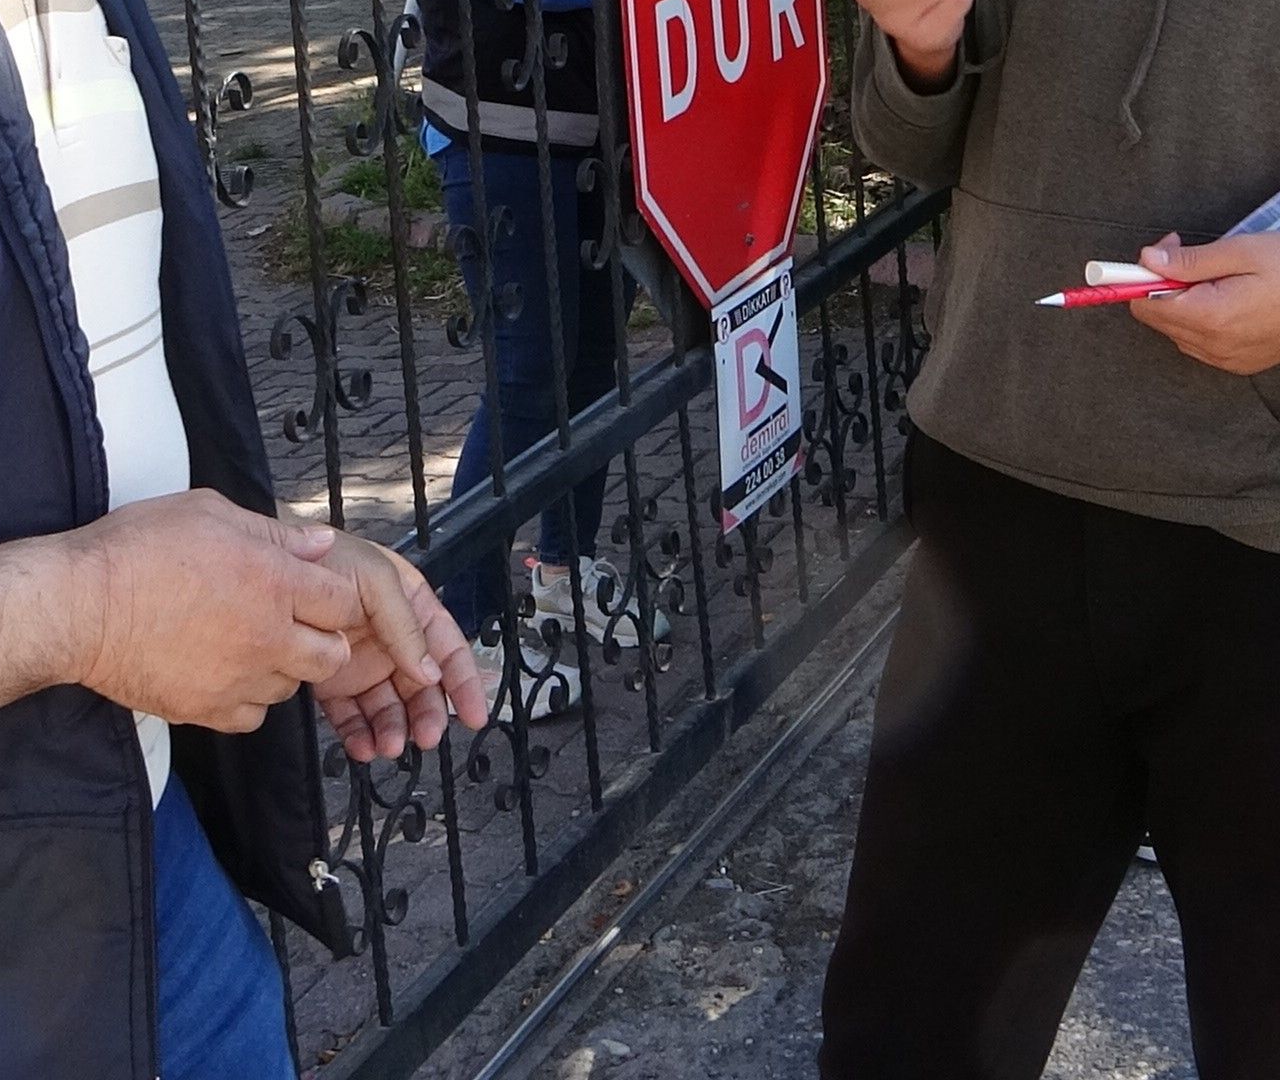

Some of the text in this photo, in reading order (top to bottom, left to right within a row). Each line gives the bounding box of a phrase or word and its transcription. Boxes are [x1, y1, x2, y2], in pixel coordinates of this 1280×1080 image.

[741, 402, 789, 462] demiral
[745, 466, 762, 495] 224
[763, 457, 774, 479] 00
